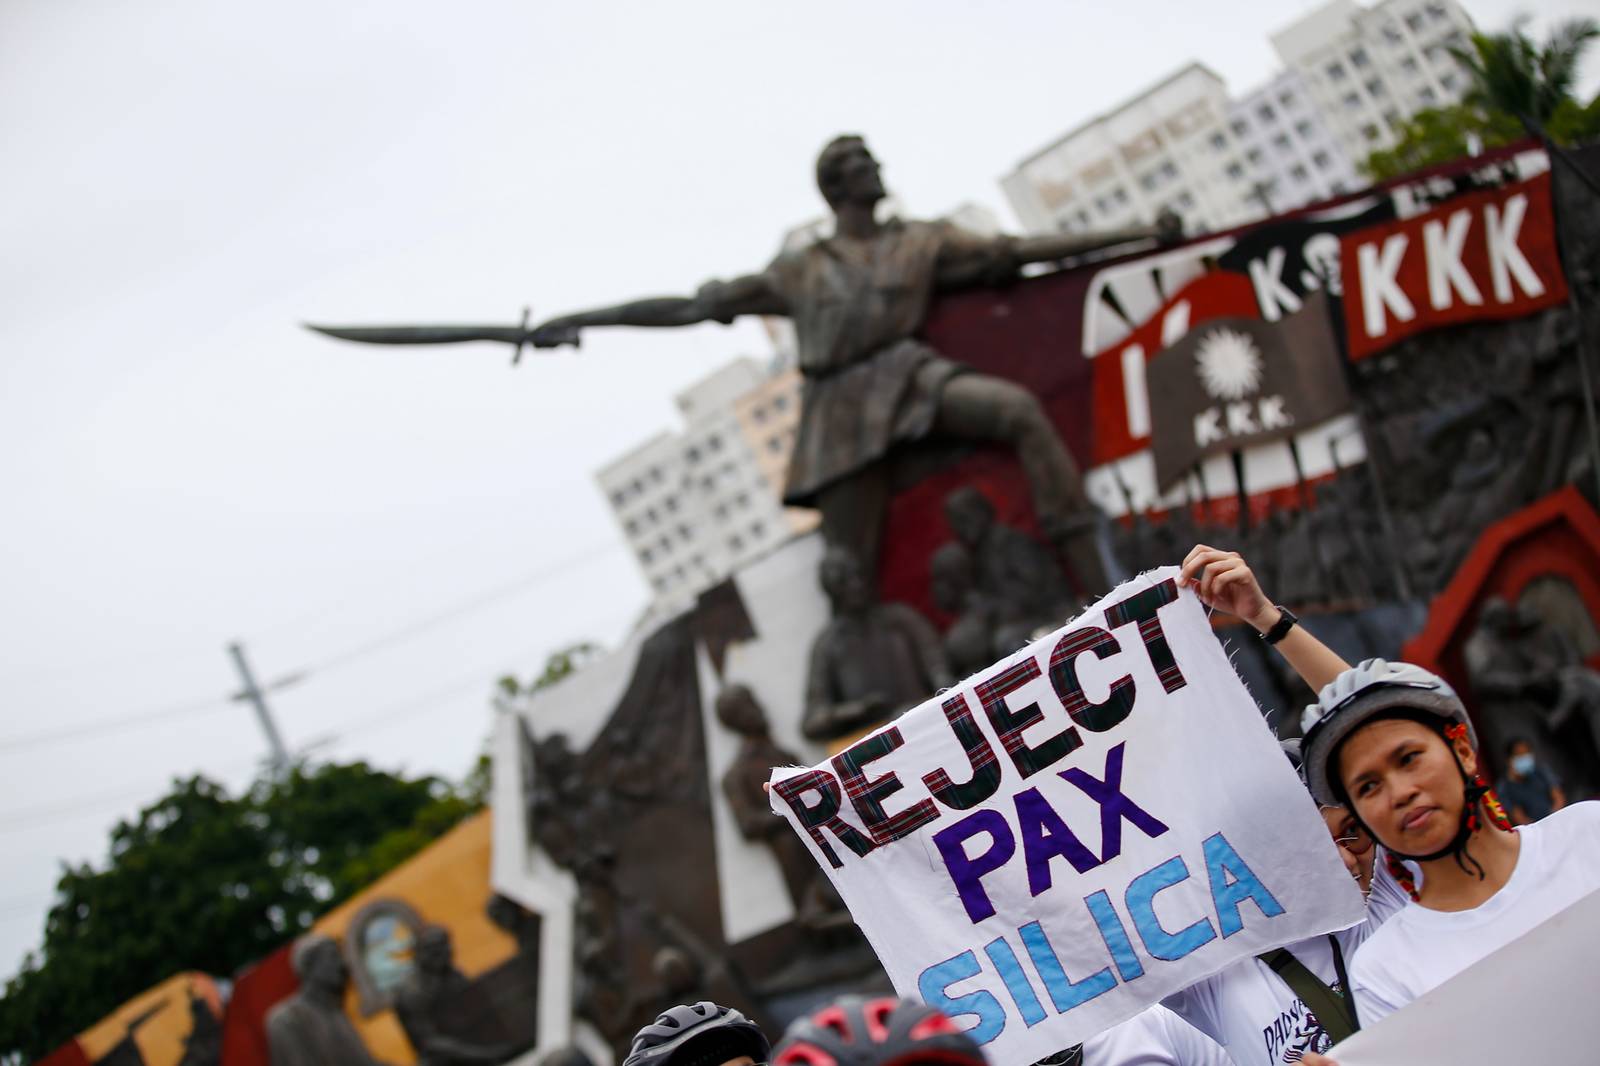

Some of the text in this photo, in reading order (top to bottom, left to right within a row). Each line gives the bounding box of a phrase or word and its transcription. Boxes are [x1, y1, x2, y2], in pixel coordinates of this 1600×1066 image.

[1356, 193, 1546, 338] KKK
[772, 577, 1187, 868] REJECT
[932, 741, 1170, 925] PAX
[917, 832, 1286, 1046] SILICA
